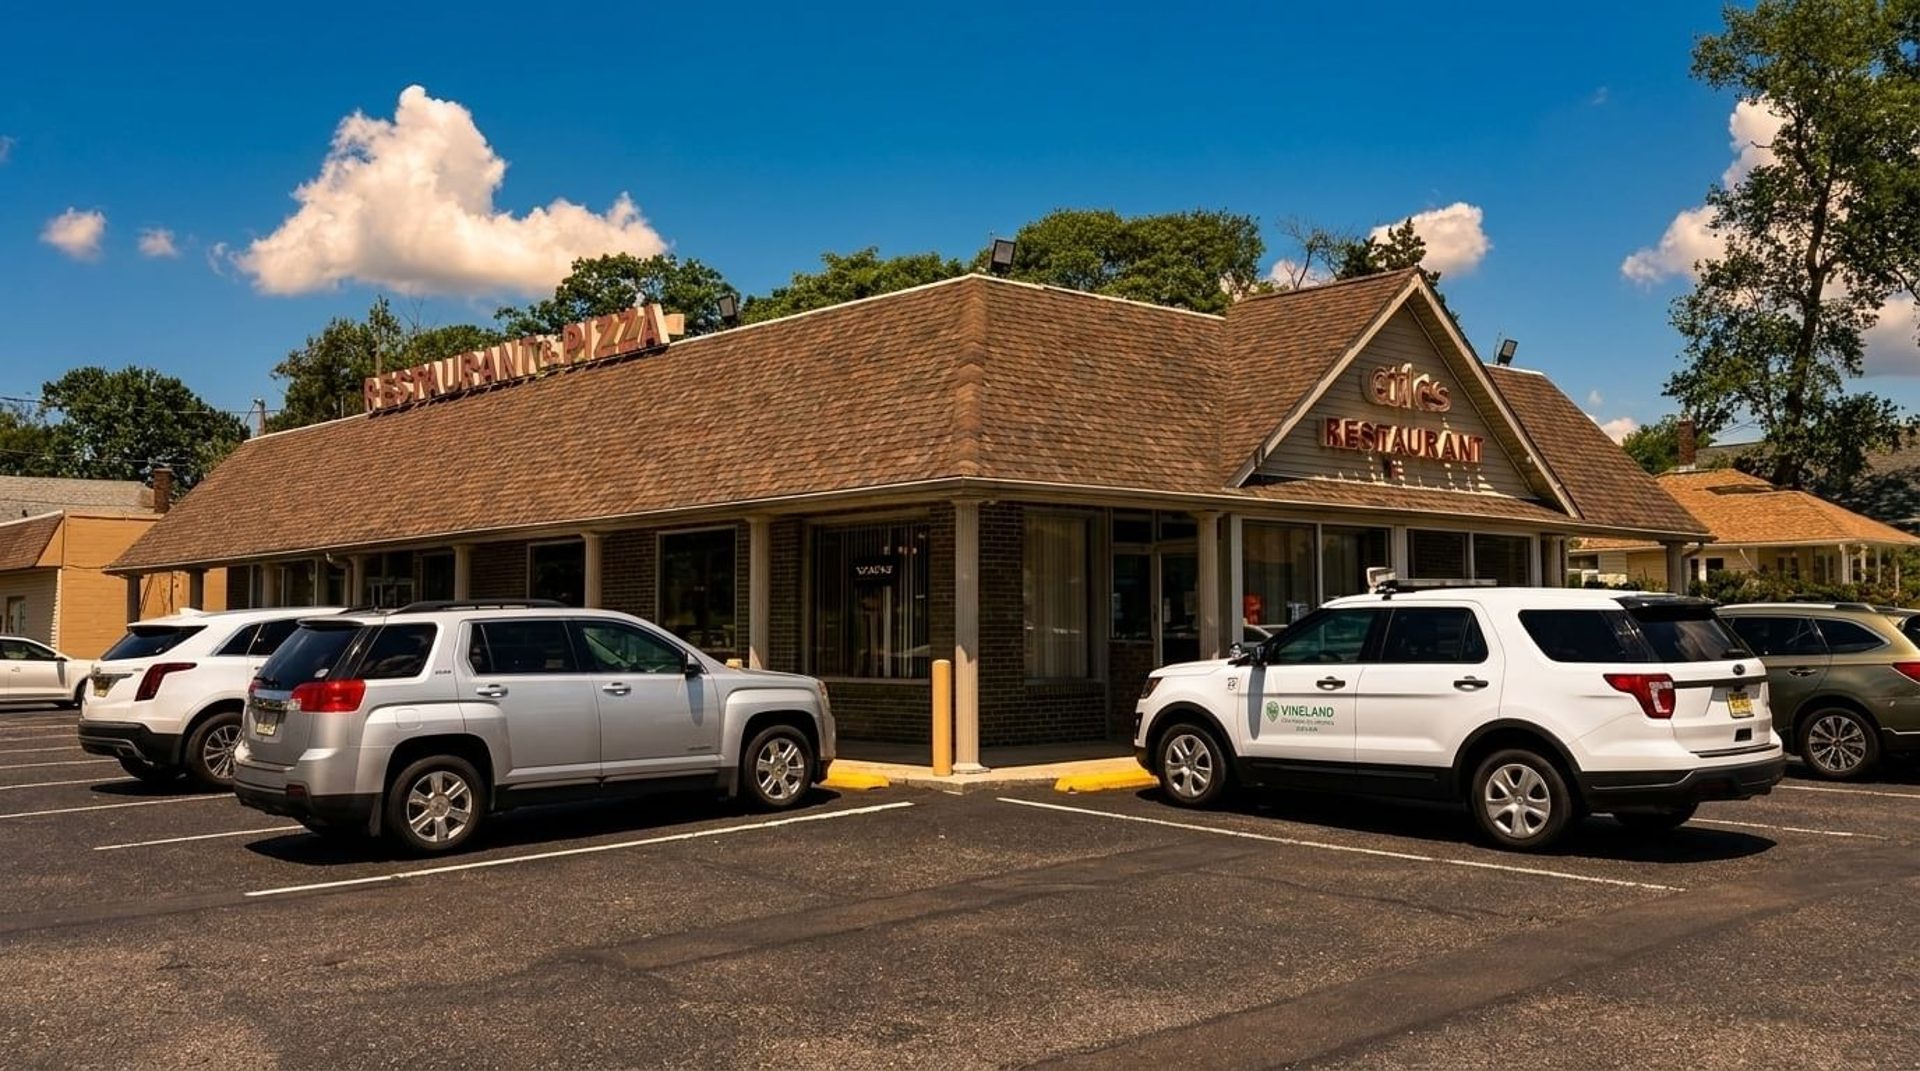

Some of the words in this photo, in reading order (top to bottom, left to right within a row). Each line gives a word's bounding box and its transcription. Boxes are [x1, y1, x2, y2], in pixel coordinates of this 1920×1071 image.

[364, 335, 541, 411] RESTAURANT
[541, 337, 561, 367] &
[562, 304, 669, 365] PIZZA
[1322, 417, 1485, 463] RESTAURANT
[1280, 704, 1335, 718] VINELAND
